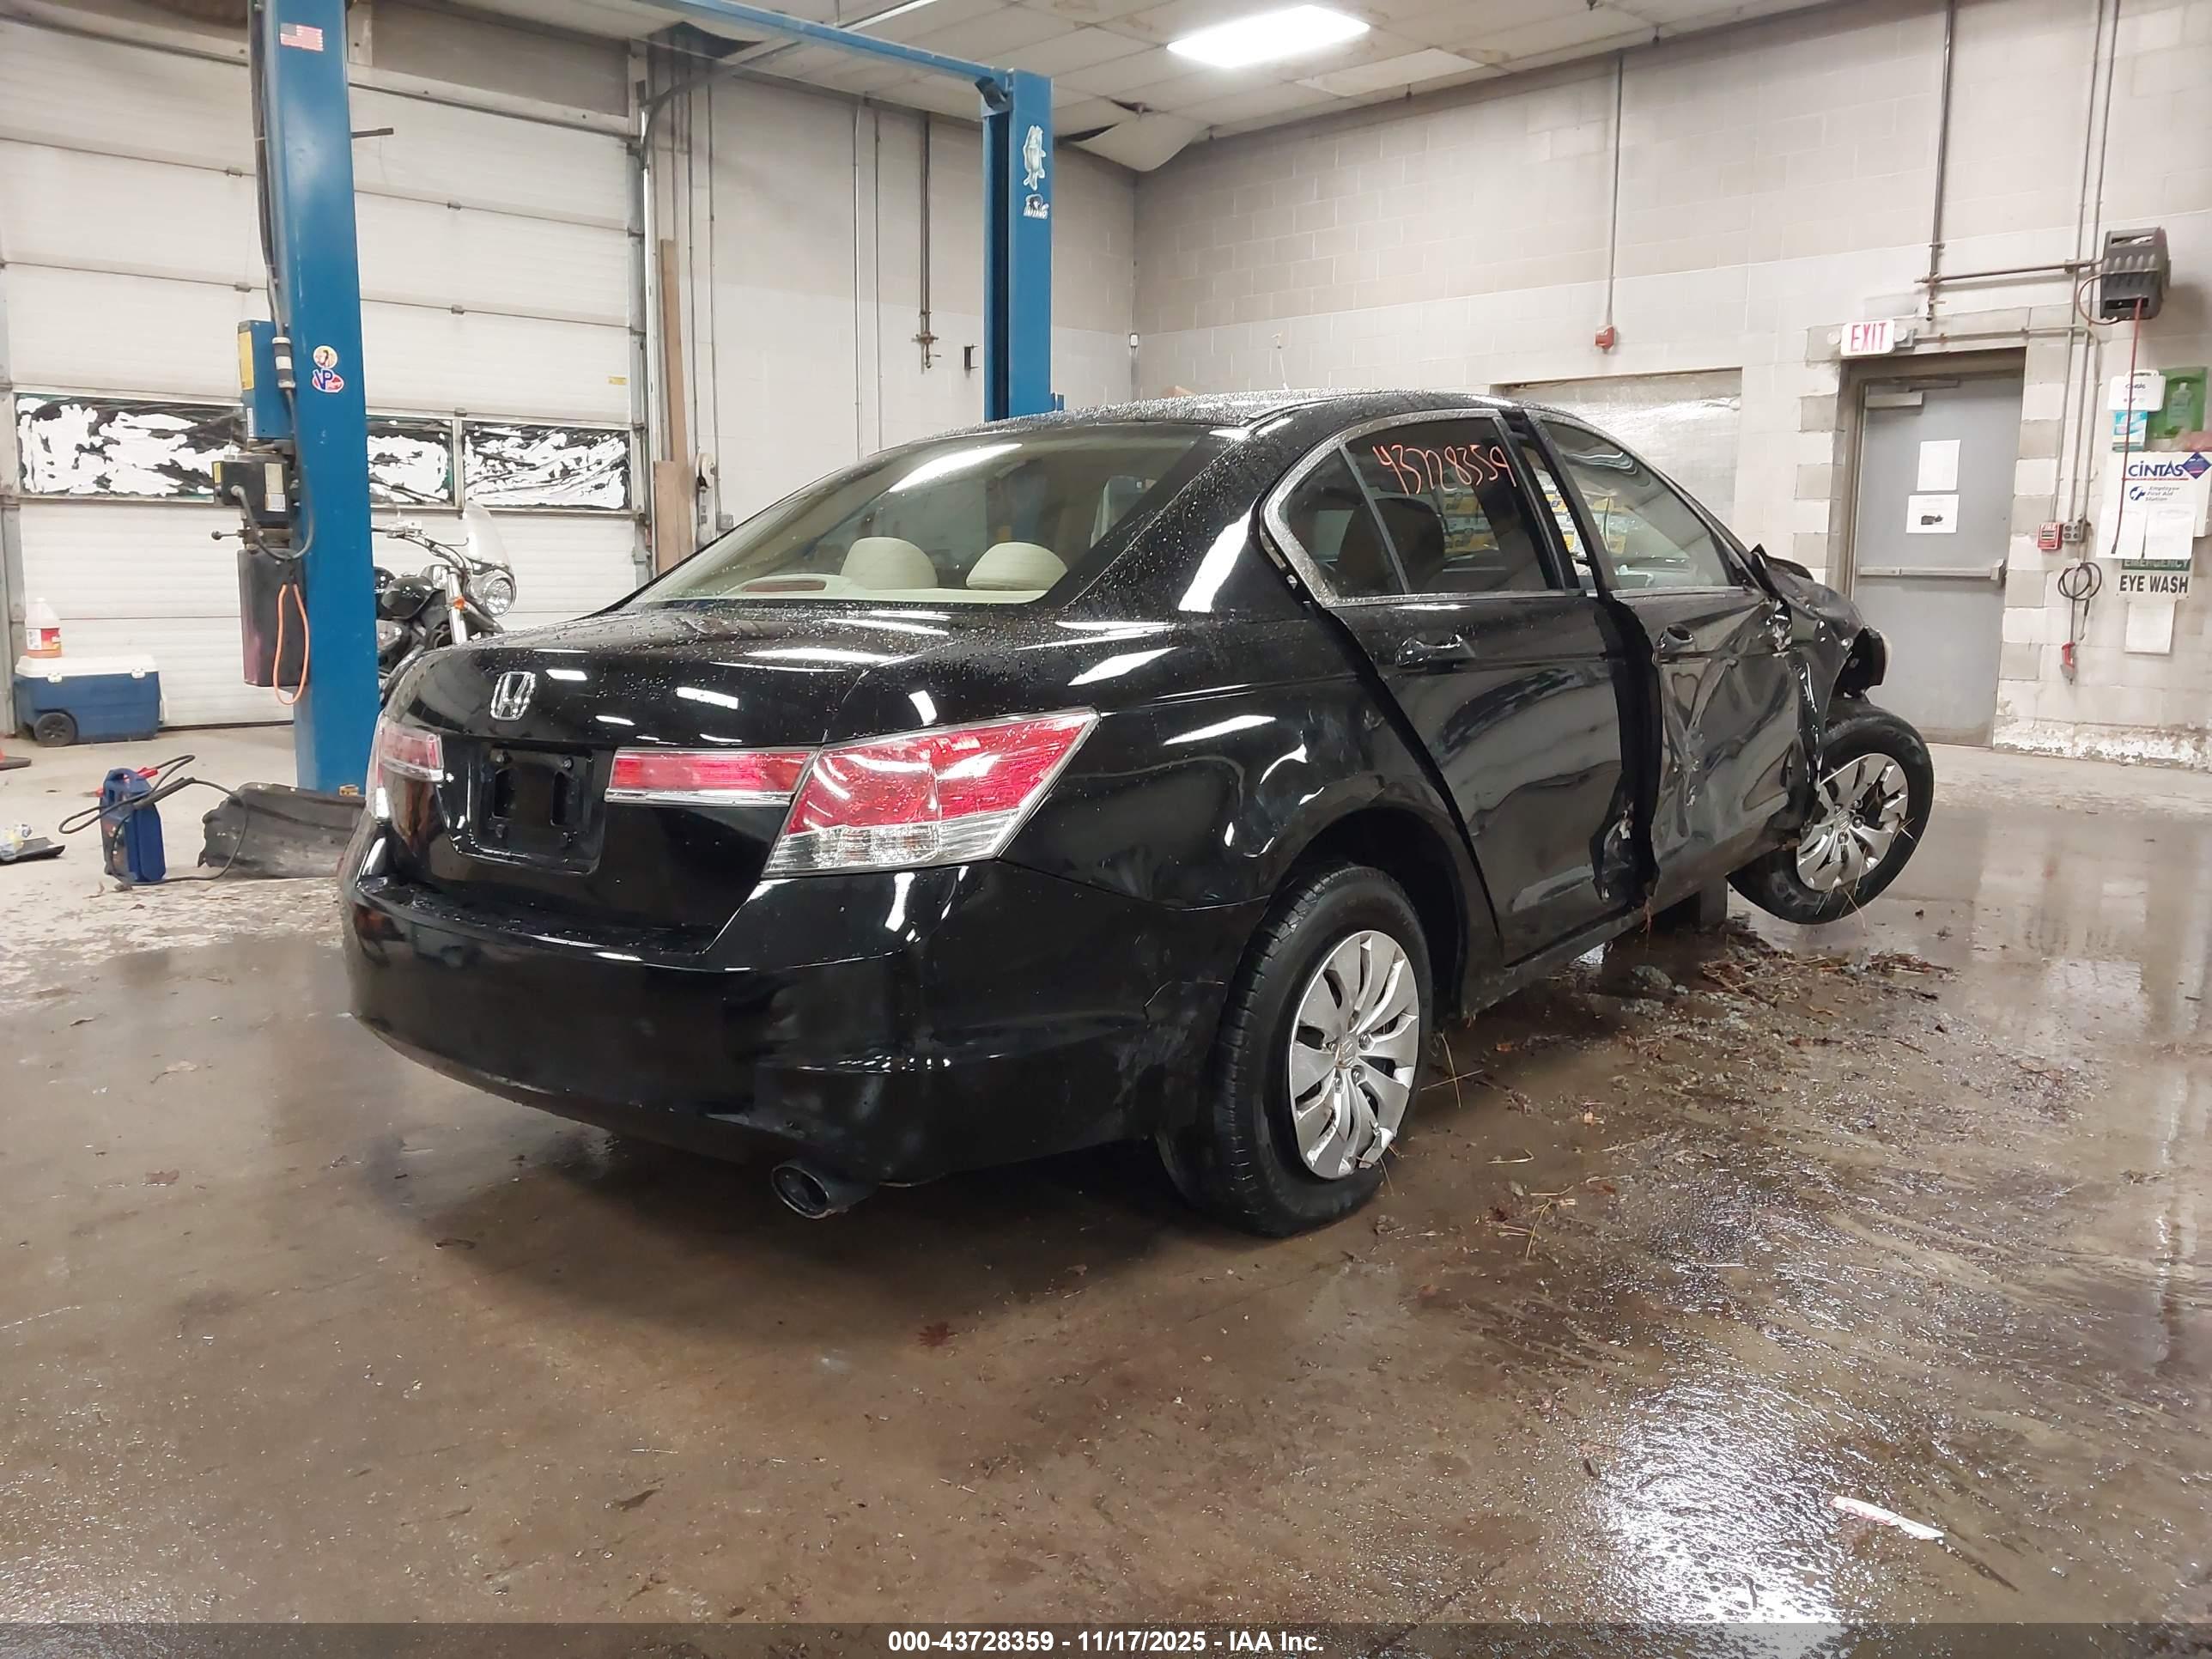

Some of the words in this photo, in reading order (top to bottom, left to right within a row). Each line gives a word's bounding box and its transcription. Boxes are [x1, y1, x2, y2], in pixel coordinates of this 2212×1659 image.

[1850, 323, 1887, 351] EXIT
[314, 370, 333, 390] VP
[2119, 574, 2145, 592] EYE
[2149, 575, 2189, 593] WASH
